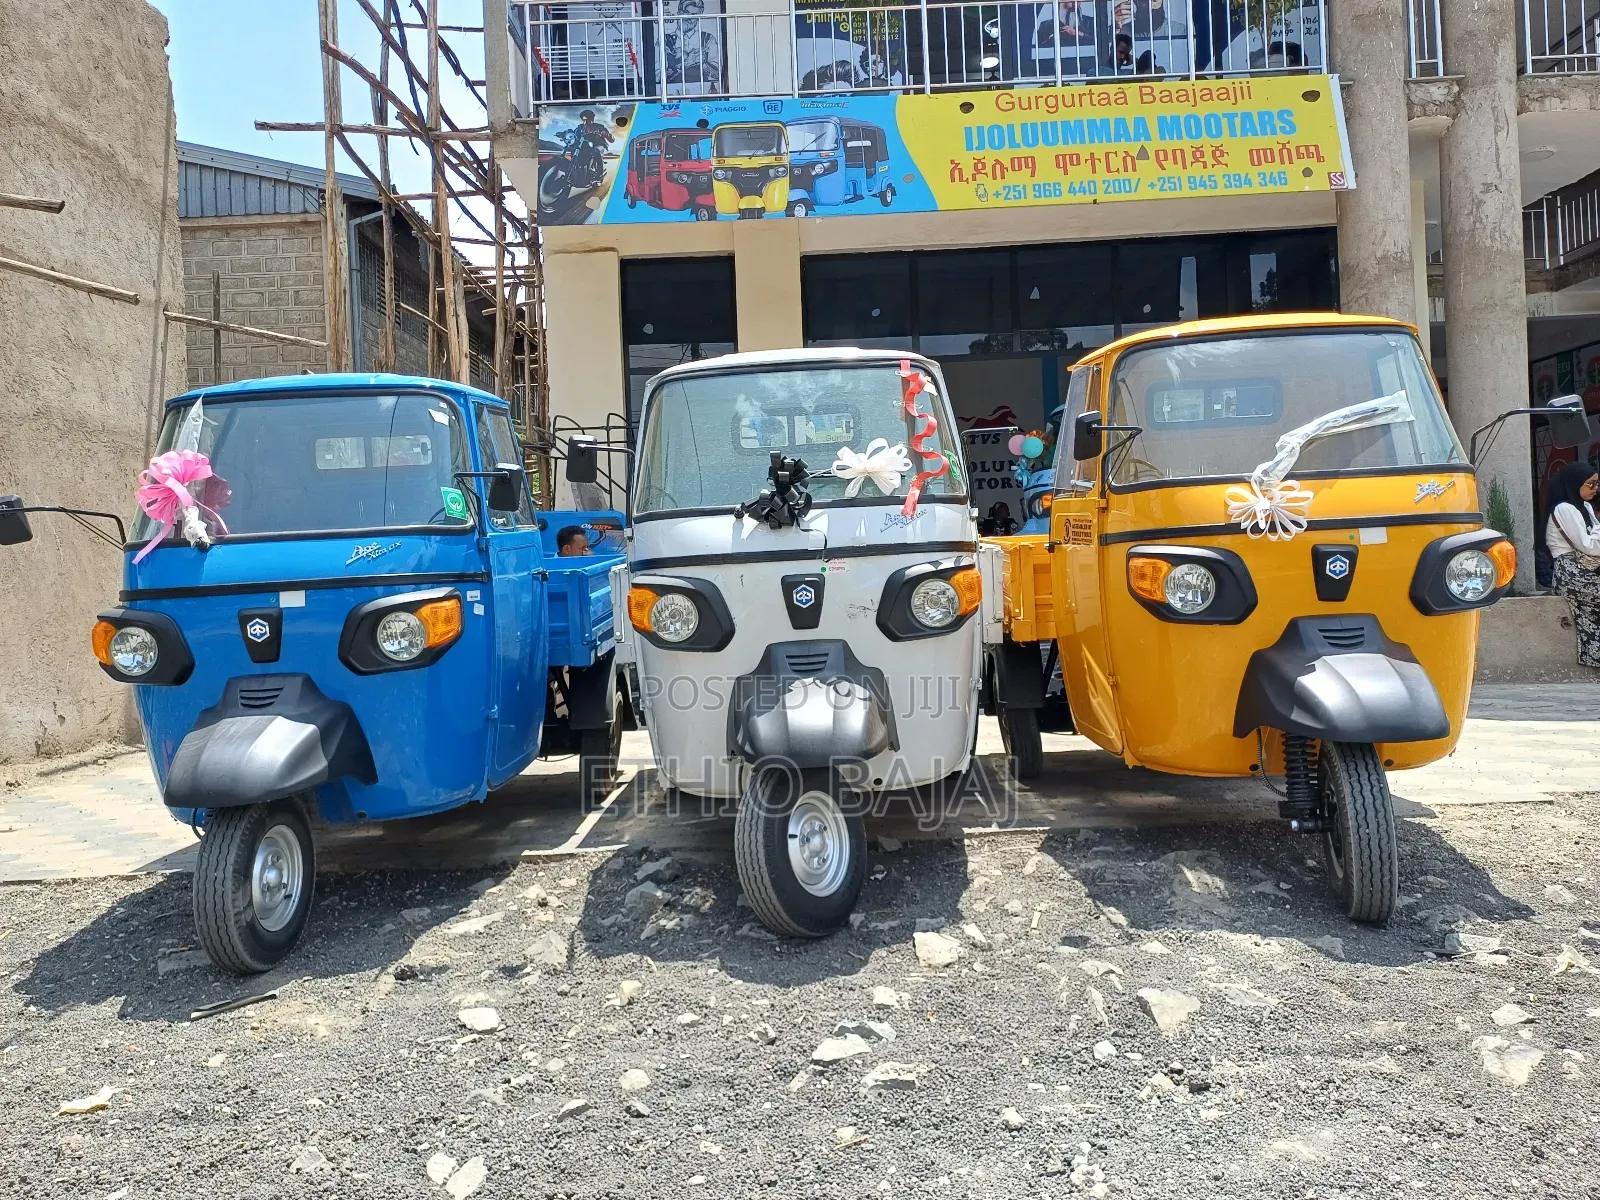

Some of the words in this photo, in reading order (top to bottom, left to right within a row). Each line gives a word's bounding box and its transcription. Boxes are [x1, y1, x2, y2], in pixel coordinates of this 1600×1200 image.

[660, 103, 681, 111] TVS
[1138, 81, 1254, 107] Baajaajii
[767, 104, 780, 112] RE
[964, 115, 1152, 152] IJOLUUMMAA
[1157, 109, 1298, 142] MOOTARS
[949, 155, 1038, 184] ኢጆሉማ
[1054, 151, 1138, 176] ሞተርስ
[1153, 143, 1230, 171] የባጃጅ
[1248, 140, 1326, 167] መሸጫ
[993, 184, 1027, 201] +251
[1032, 182, 1063, 199] 966
[1067, 180, 1098, 197] 440
[1102, 177, 1142, 195] 200/
[1147, 175, 1183, 192] +251
[1187, 174, 1218, 191] 945
[1222, 172, 1253, 189] 394
[1257, 170, 1288, 187] 346
[969, 432, 1001, 445] TVS
